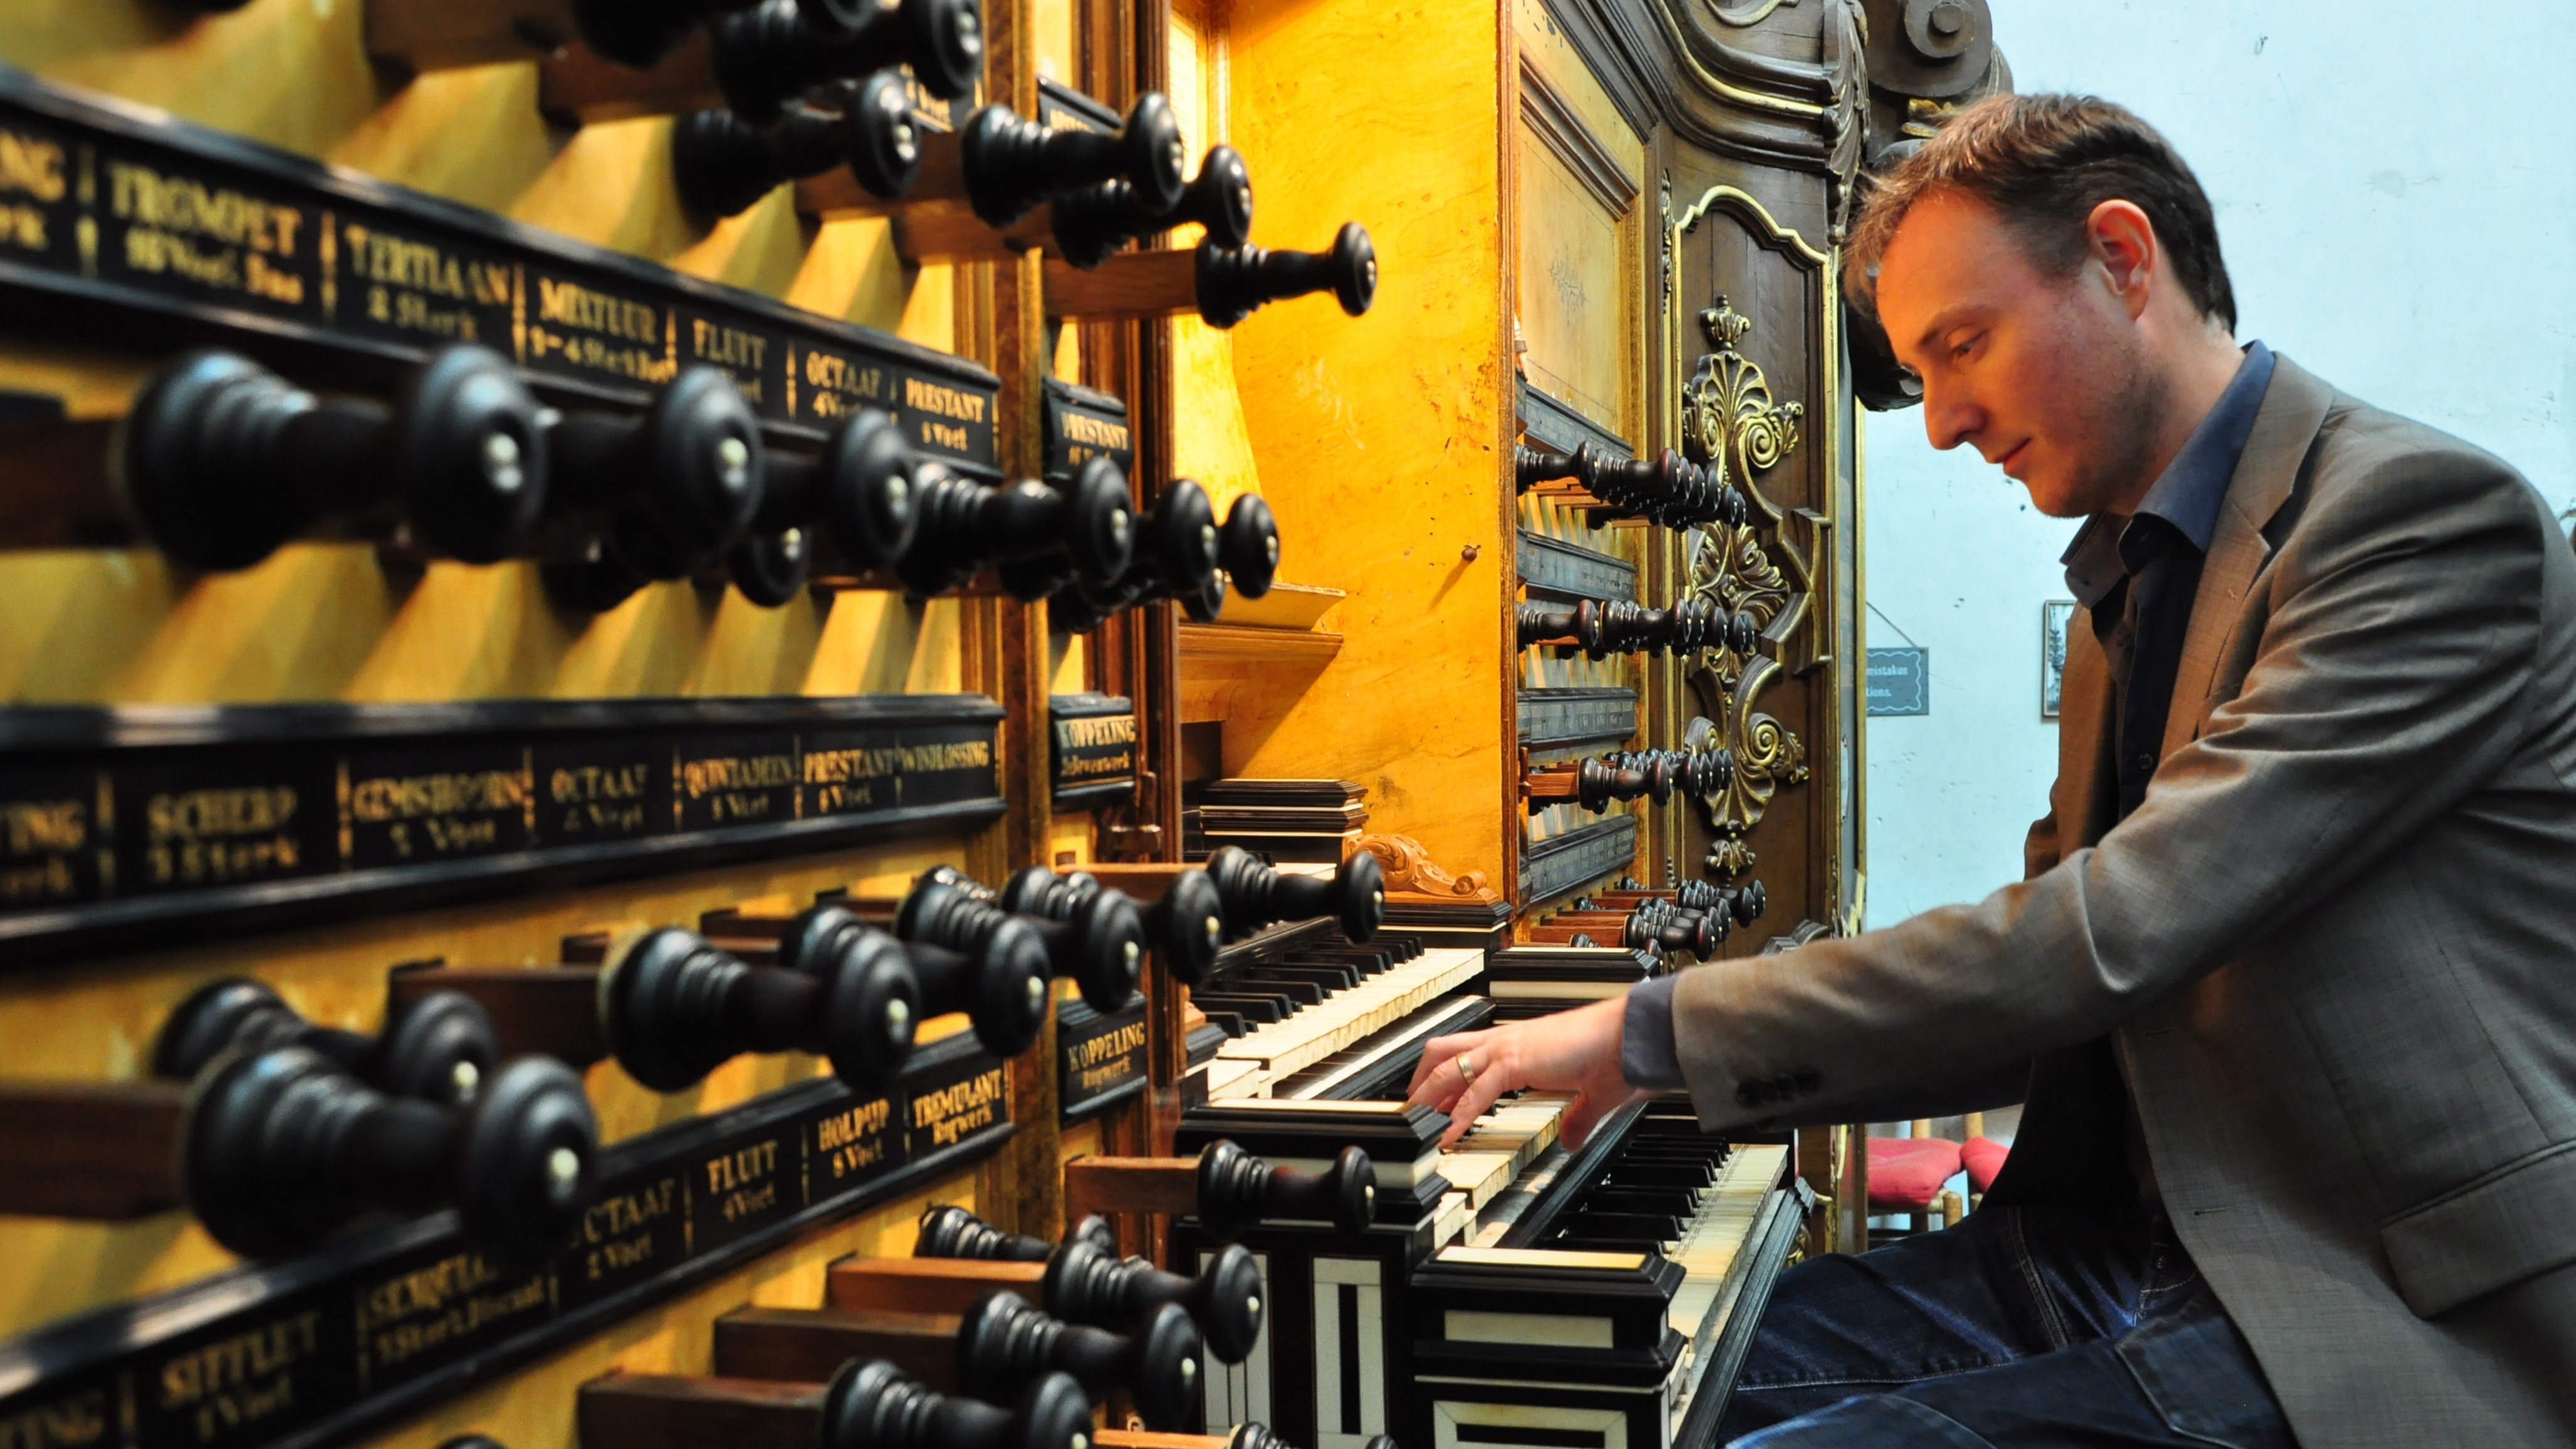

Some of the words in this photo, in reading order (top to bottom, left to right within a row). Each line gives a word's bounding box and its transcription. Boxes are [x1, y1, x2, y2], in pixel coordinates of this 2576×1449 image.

[108, 161, 302, 257] TROMPET
[345, 223, 509, 305] TERTIAAN
[693, 317, 766, 371] FLUIT
[806, 350, 881, 400] OCTAAF
[906, 378, 985, 424] PRESTANT
[932, 423, 968, 452] Voet
[1055, 720, 1137, 749] KOPPELING
[551, 762, 648, 804] OCTAAF
[803, 749, 894, 783] PRESTANT
[1068, 1021, 1145, 1072] KOPPELING
[913, 1068, 1002, 1128] TREMULANT
[932, 1101, 993, 1145] Rugwerk
[706, 1139, 778, 1196] FLUIT
[845, 1138, 884, 1170] Voet
[570, 1177, 675, 1250] CTAAF
